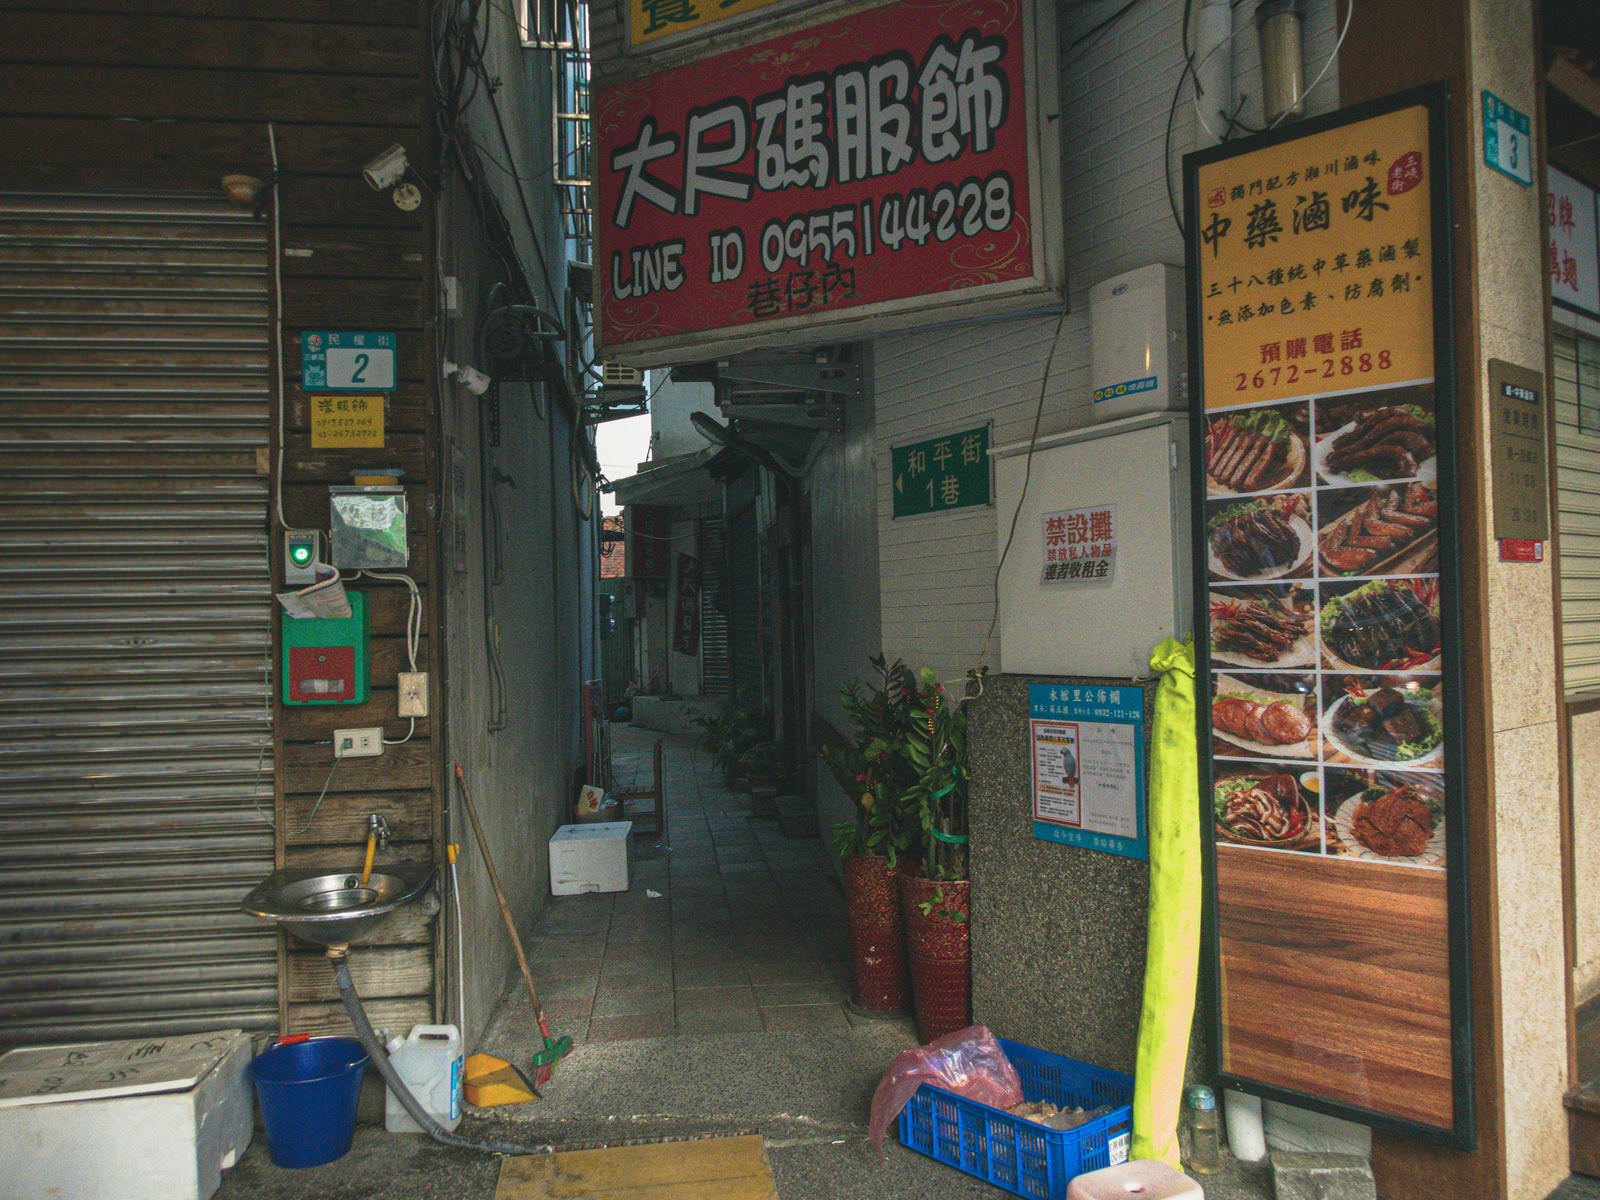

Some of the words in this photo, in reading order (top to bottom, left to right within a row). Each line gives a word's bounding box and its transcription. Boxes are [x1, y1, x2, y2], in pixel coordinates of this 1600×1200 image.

[611, 32, 1006, 229] 大尺碼服飾
[1509, 133, 1519, 169] 3
[612, 242, 685, 300] LINE
[709, 231, 743, 283] ID
[761, 175, 1012, 273] 0955144228
[1201, 176, 1390, 259] 中藥滷味
[748, 266, 856, 317] 巷仔內
[1259, 327, 1364, 364] 預購電話
[351, 353, 370, 383] 2
[1235, 350, 1392, 391] 2672-2888
[907, 433, 981, 478] 和平街
[926, 476, 960, 507] 1巷
[1046, 511, 1112, 546] 禁設攤
